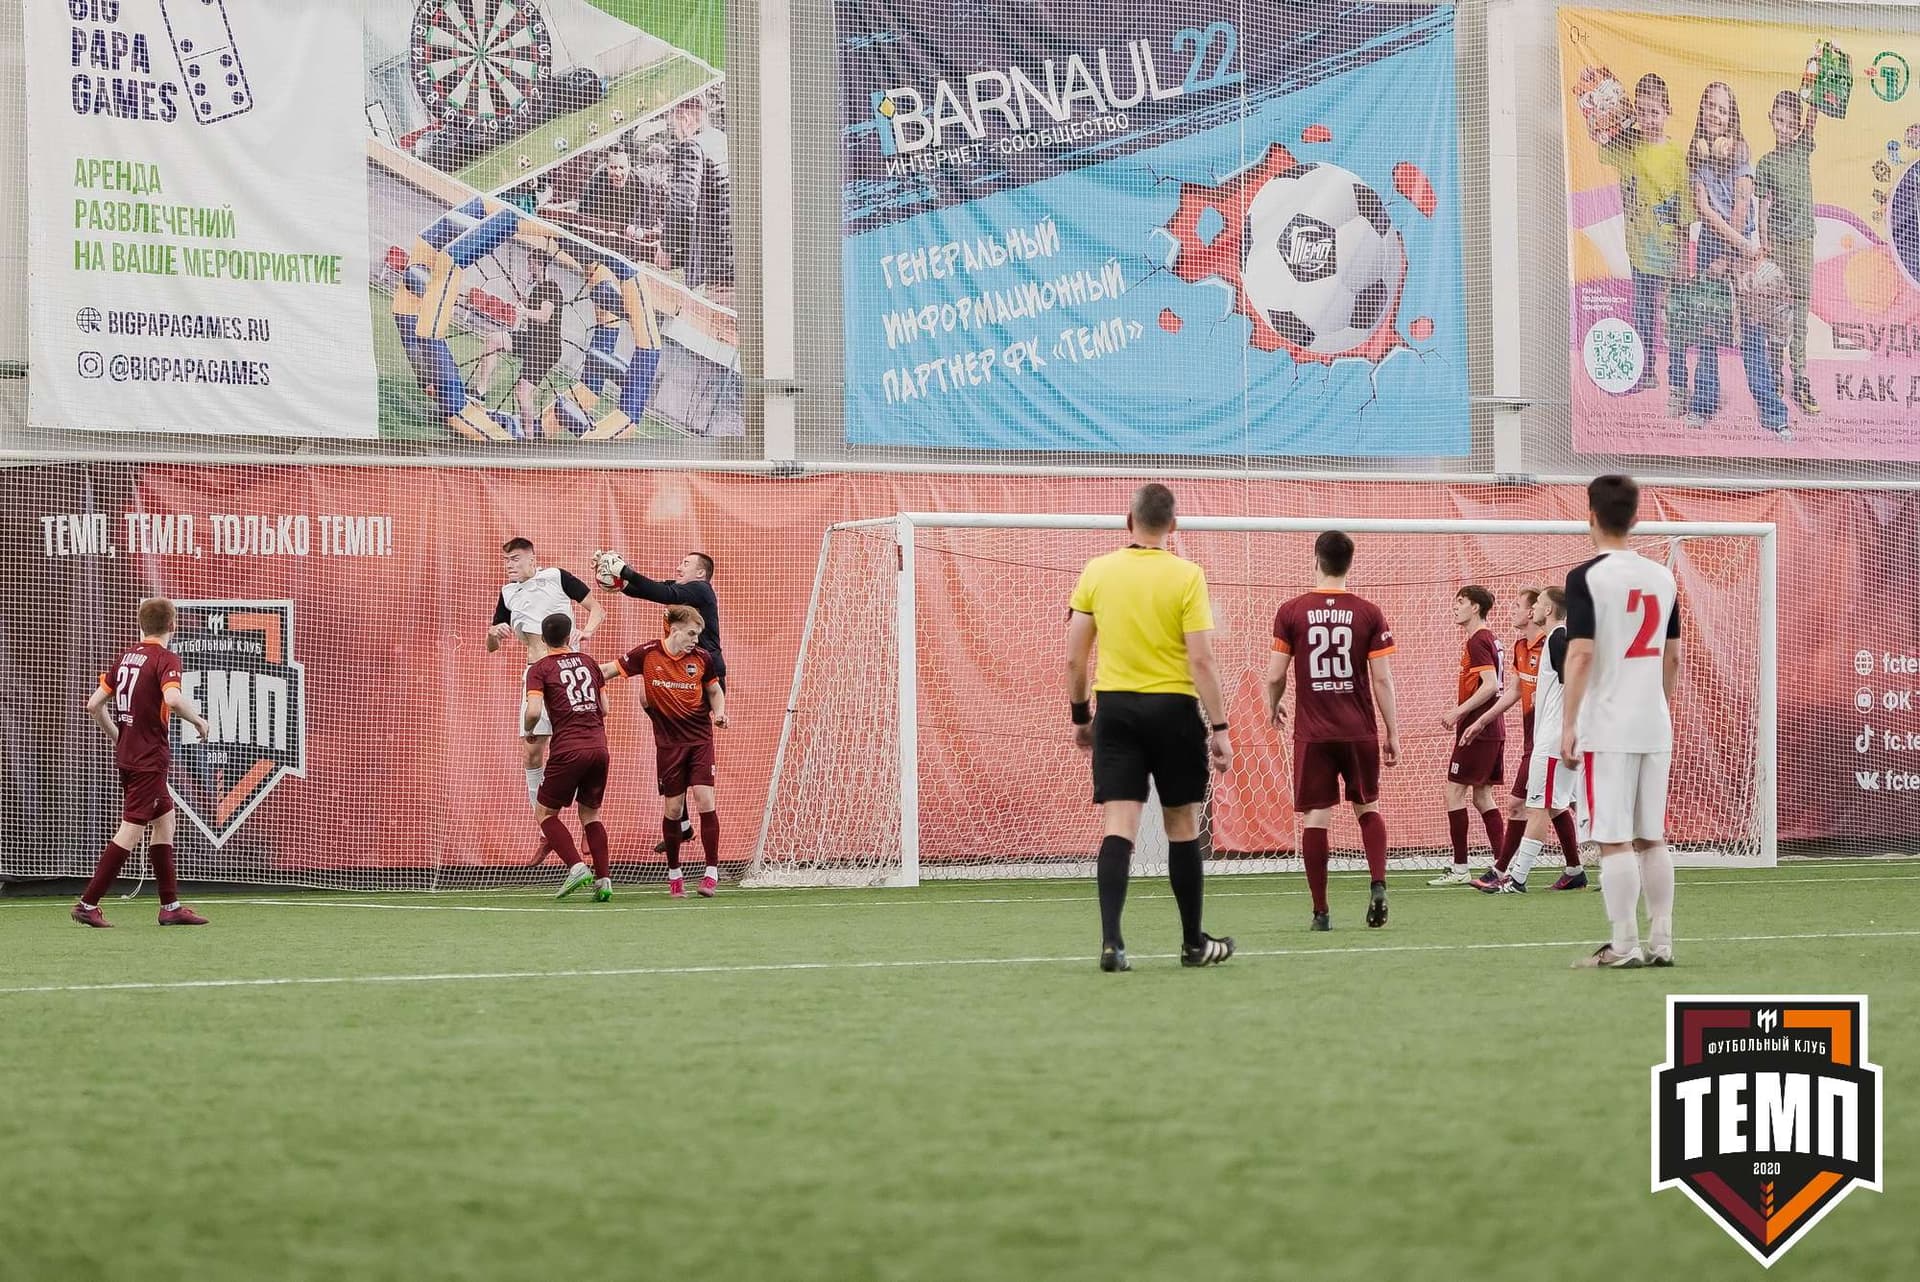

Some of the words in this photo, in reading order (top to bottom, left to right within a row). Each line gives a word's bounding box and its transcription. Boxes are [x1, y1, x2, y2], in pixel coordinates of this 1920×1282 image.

[71, 26, 150, 74] PAPA
[71, 74, 177, 123] GAMES
[886, 144, 982, 177] ИНТЕРНЕТ
[1000, 113, 1130, 155] СООБЩЕСТВО
[74, 158, 162, 195] АРЕНДА
[74, 199, 236, 239] РАЗВЛЕЧЕНИЙ
[73, 240, 106, 271] НА
[112, 242, 178, 276] ВАШЕ
[184, 247, 343, 285] МЕРОПРИЯТИЕ
[880, 216, 1060, 288] ГЕНЕРАЛЬНЫЙ
[882, 257, 1126, 349] ИНФОРМАЦИОННЫЙ
[108, 310, 270, 342] BIGPAPAGAMES.RU
[109, 354, 270, 386] @BIGPAPAGAMES
[882, 349, 996, 405] ПАРТНЕР
[1003, 336, 1047, 374] ФК
[1051, 317, 1144, 363] «ТЕМП»
[1836, 373, 1898, 402] КАК
[41, 513, 116, 558] ТЕМП,
[125, 513, 201, 559] ТЕМП,
[211, 514, 310, 555] ТОЛЬКО
[318, 515, 393, 556] ТЕМП!
[1307, 609, 1353, 625] ВОРОНА
[1625, 589, 1660, 658] 2
[236, 641, 262, 655] КЛУБ
[1308, 626, 1353, 678] 23
[116, 666, 140, 712] 27
[560, 666, 596, 706] 22
[1311, 681, 1354, 691] SEUS
[1882, 690, 1912, 711] ФК
[181, 669, 287, 751] ЕМП
[207, 752, 228, 764] 2020
[1450, 762, 1460, 775] 18
